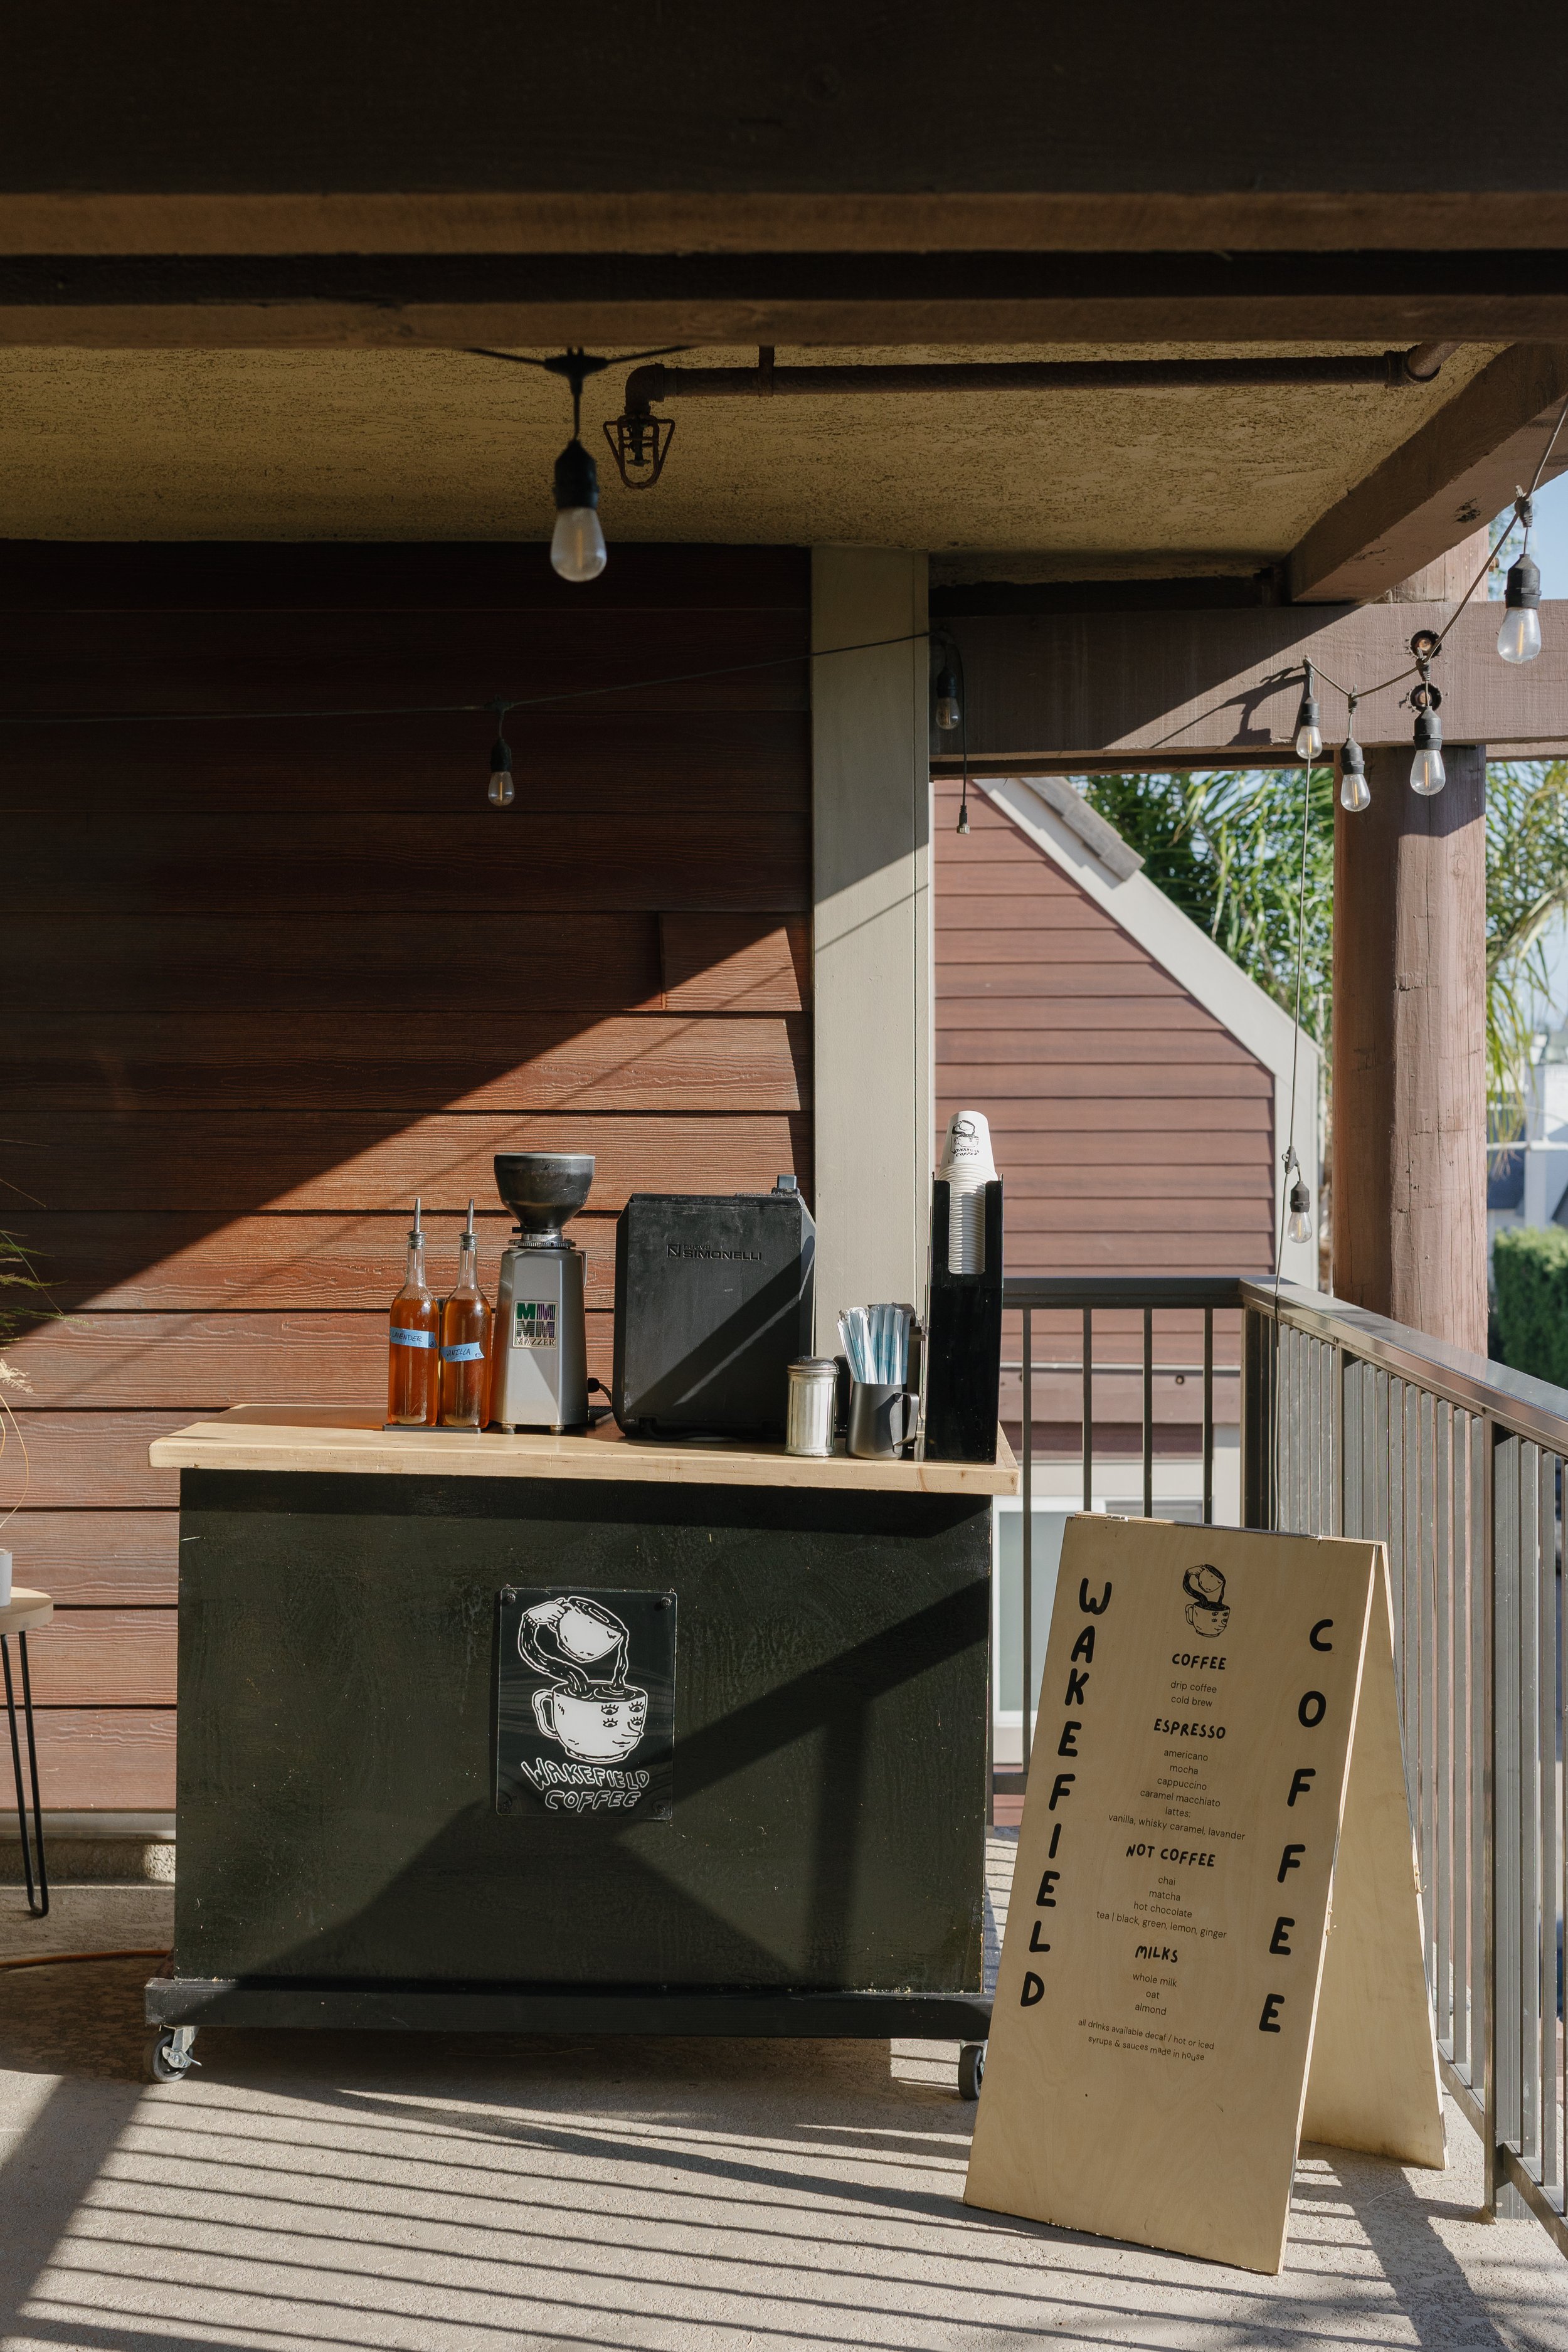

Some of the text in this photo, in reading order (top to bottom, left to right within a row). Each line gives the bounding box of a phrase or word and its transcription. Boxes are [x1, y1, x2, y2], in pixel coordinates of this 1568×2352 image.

[683, 1250, 762, 1261] SIMONELLI
[392, 1331, 423, 1343] LAVENDER
[515, 1337, 556, 1346] MAZZER
[446, 1347, 471, 1357] VANILLA
[1172, 1653, 1227, 1670] COFFEE
[1170, 1680, 1217, 1693] drip coffee
[1171, 1695, 1213, 1707] cold brew
[1153, 1718, 1226, 1739] ESPRESSO
[1163, 1749, 1209, 1762] americano
[521, 1757, 650, 1791] WAKEFIELD
[1169, 1764, 1199, 1775] mocha
[1157, 1777, 1207, 1791] cappuccino
[1020, 1577, 1112, 2007] WAKEFIELD
[1140, 1789, 1221, 1807] caramel macchiato
[544, 1791, 642, 1813] COFFEE
[1165, 1806, 1191, 1818] lattes:
[1108, 1814, 1246, 1841] vanilla, whisky caramel, lavander
[1259, 1619, 1333, 2033] COFFEE
[1126, 1843, 1216, 1867] NOT COFFEE
[1158, 1876, 1176, 1886] chai
[1148, 1890, 1181, 1902] matcha
[1133, 1901, 1193, 1919] hot chocolate
[1096, 1910, 1110, 1920] tea
[1116, 1913, 1140, 1926] black,
[1142, 1919, 1168, 1931] green,
[1170, 1922, 1198, 1935] lemon,
[1200, 1927, 1227, 1940] ginger
[1135, 1945, 1179, 1963] MILKS
[1133, 1973, 1178, 1988] whole milk
[1146, 1991, 1160, 2000] oat
[1135, 2003, 1167, 2016] almond
[1088, 2020, 1110, 2032] drinks
[1111, 2026, 1143, 2037] available
[1145, 2030, 1167, 2041] decaf
[1173, 2035, 1187, 2045] hot
[1198, 2040, 1215, 2050] iced
[1088, 2035, 1113, 2047] syrups
[1122, 2042, 1148, 2051] sauces
[1150, 2047, 1172, 2056] made
[1173, 2048, 1180, 2058] in
[1182, 2052, 1205, 2062] house
